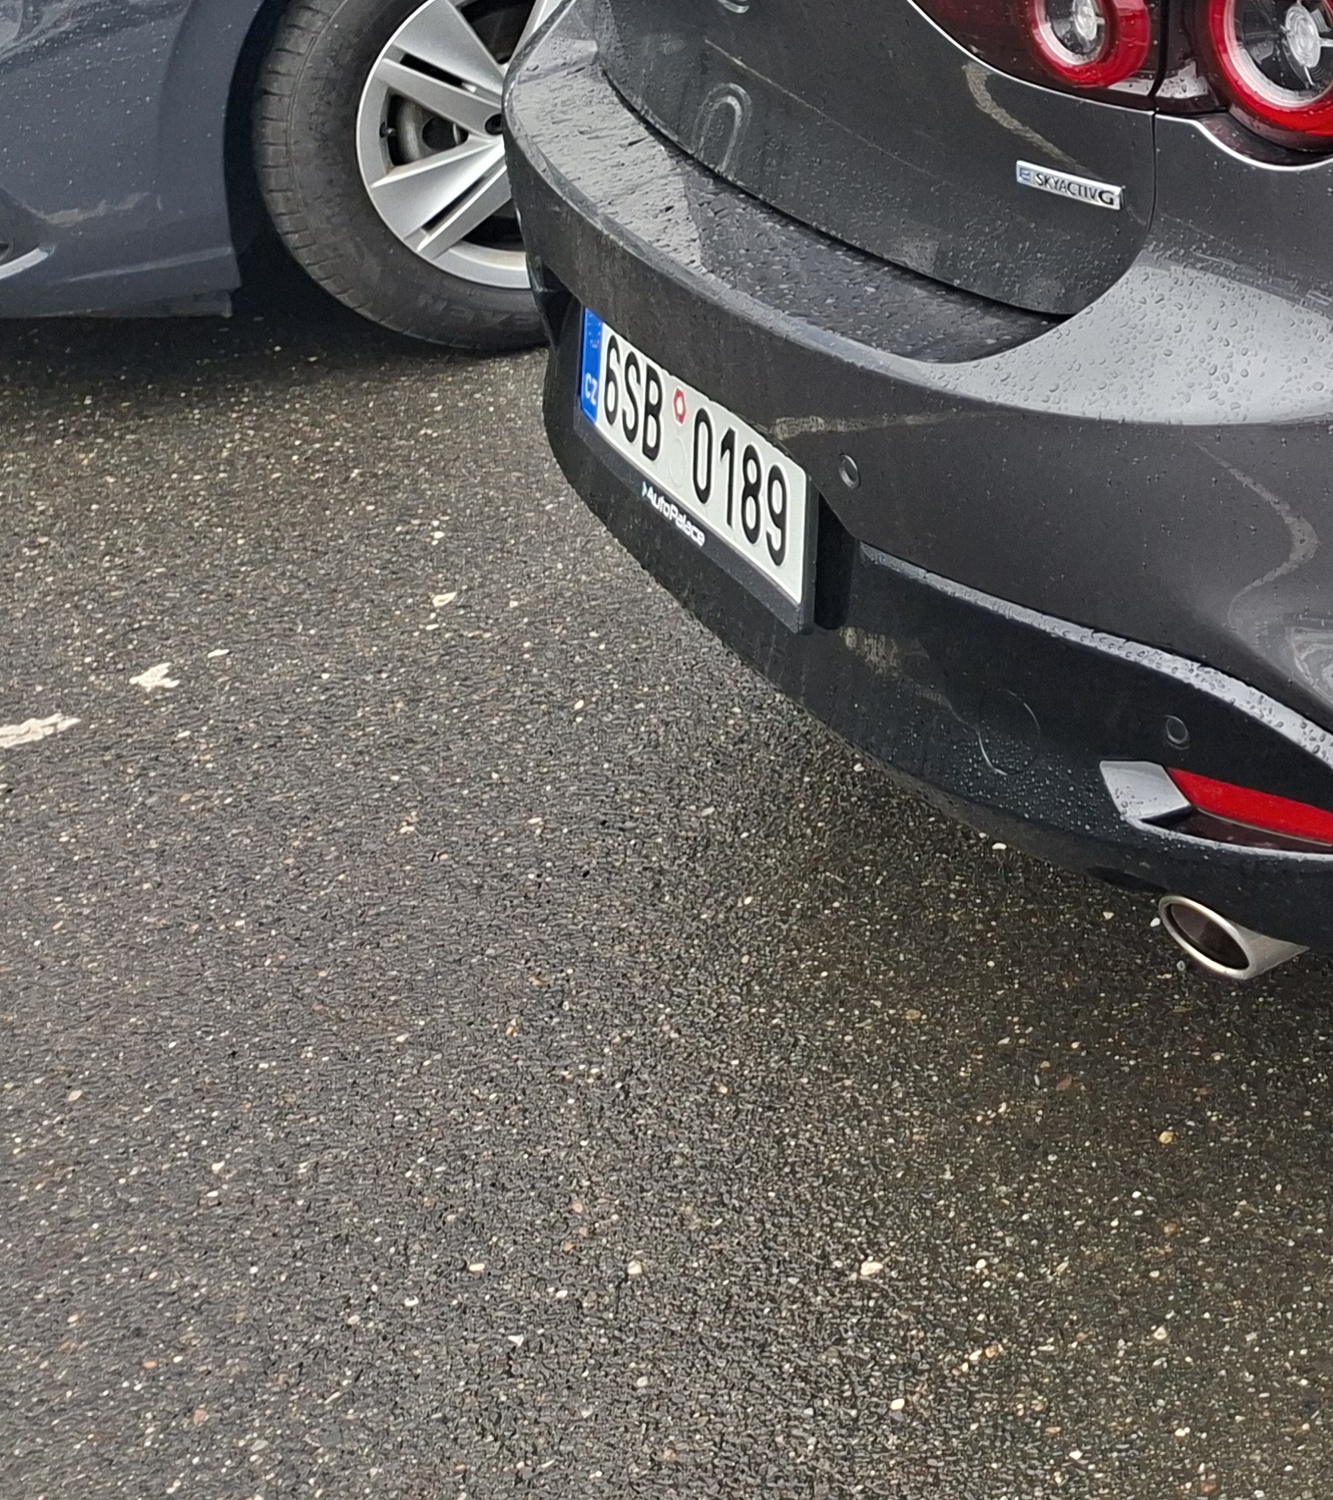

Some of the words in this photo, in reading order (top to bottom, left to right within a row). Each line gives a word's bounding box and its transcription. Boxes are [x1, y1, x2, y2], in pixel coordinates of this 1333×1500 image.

[584, 372, 598, 406] CZ
[603, 334, 663, 462] 6SB
[692, 407, 788, 567] 0189
[646, 486, 706, 548] AutoPalace
